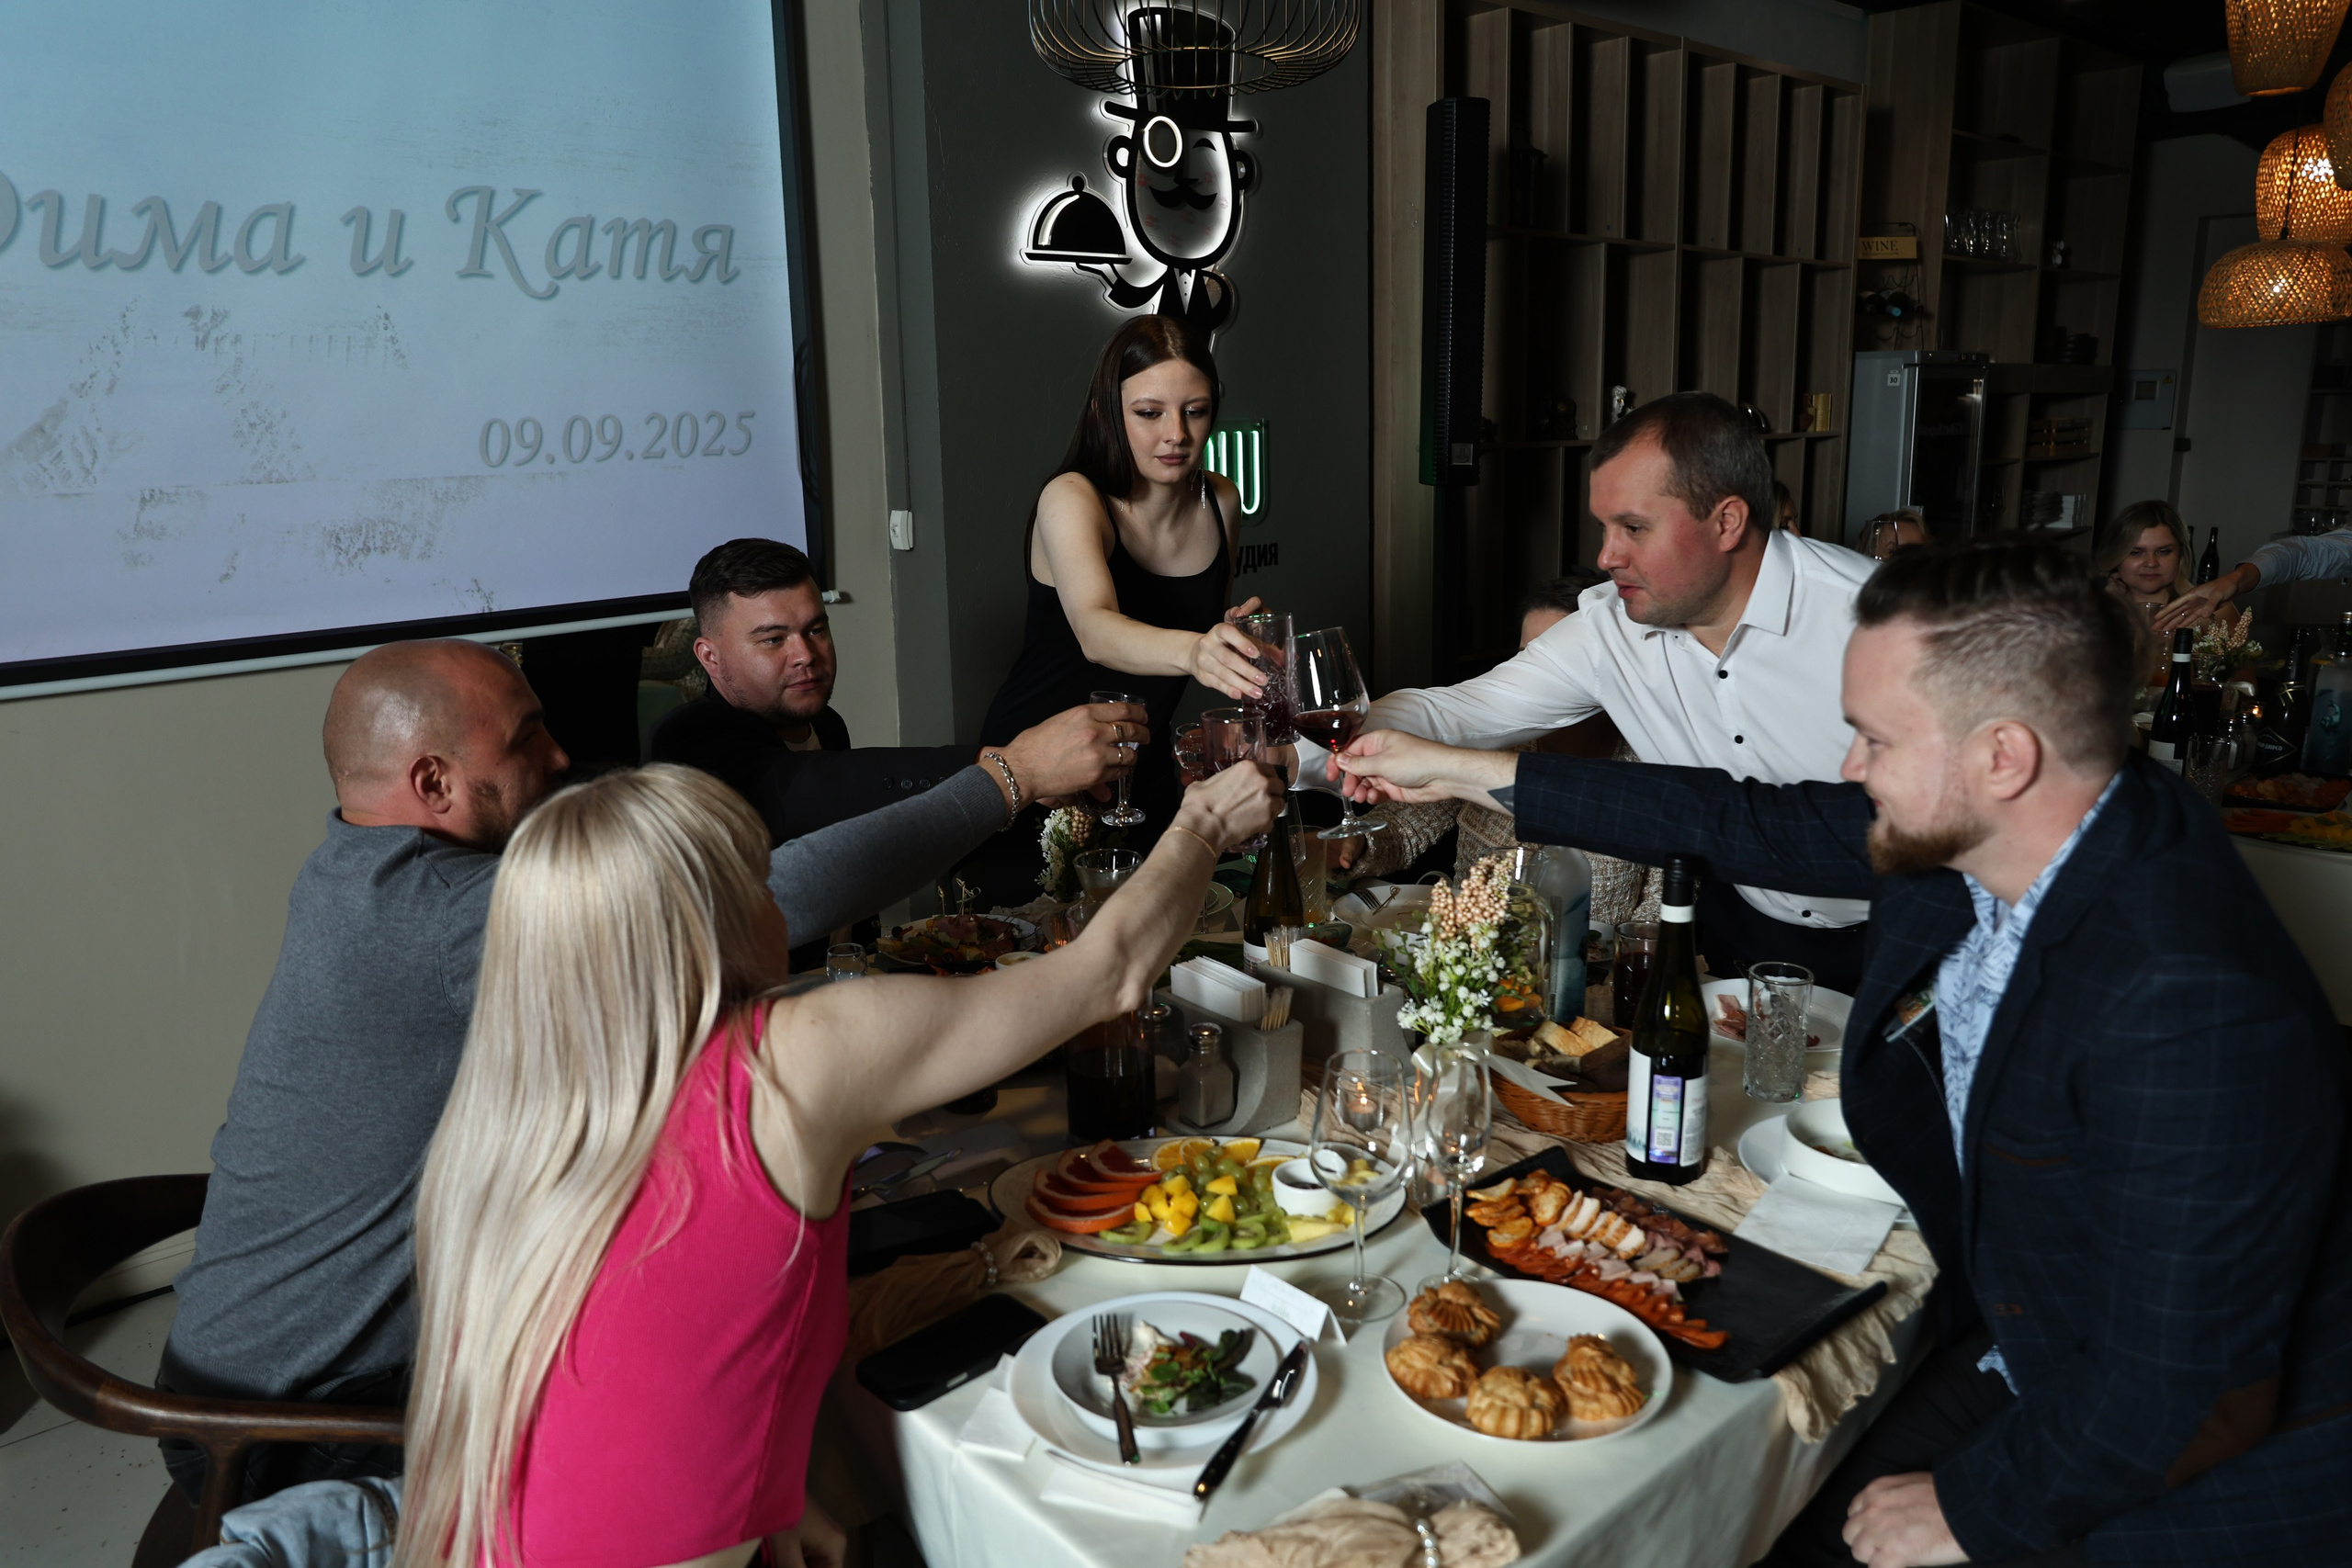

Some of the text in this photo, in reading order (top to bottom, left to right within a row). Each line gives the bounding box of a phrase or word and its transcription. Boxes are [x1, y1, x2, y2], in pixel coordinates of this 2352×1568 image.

[0, 170, 741, 299] има и Катя
[1861, 240, 1899, 252] WINE
[478, 409, 756, 468] 09.09.2025
[1234, 543, 1278, 578] удия
